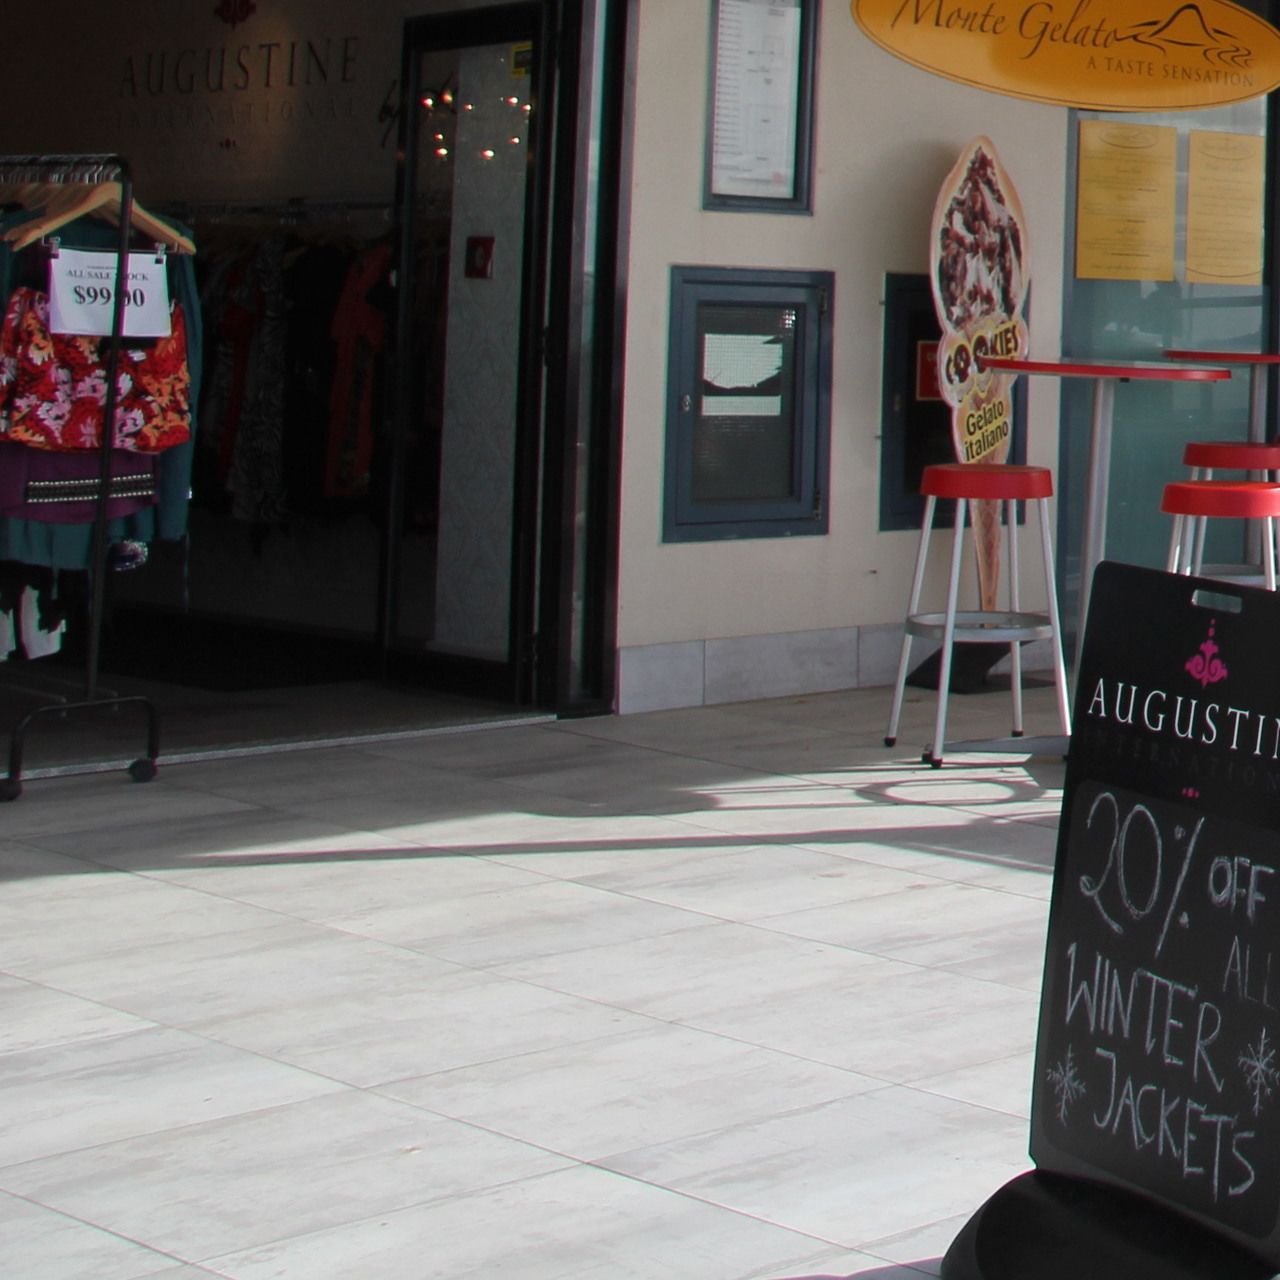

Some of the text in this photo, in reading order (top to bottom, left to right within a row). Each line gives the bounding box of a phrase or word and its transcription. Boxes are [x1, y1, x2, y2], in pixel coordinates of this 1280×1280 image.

[119, 36, 360, 97] AUGUSTINE
[1087, 55, 1254, 88] A TASTE SENSATION
[945, 324, 1019, 385] COOKIES
[964, 421, 1009, 462] italiano
[965, 400, 1004, 437] Gelato
[1078, 791, 1277, 959] 20% OFF
[1222, 935, 1278, 1011] ALL
[1063, 940, 1226, 1095] WINTER
[1093, 1046, 1257, 1204] JACKETS
